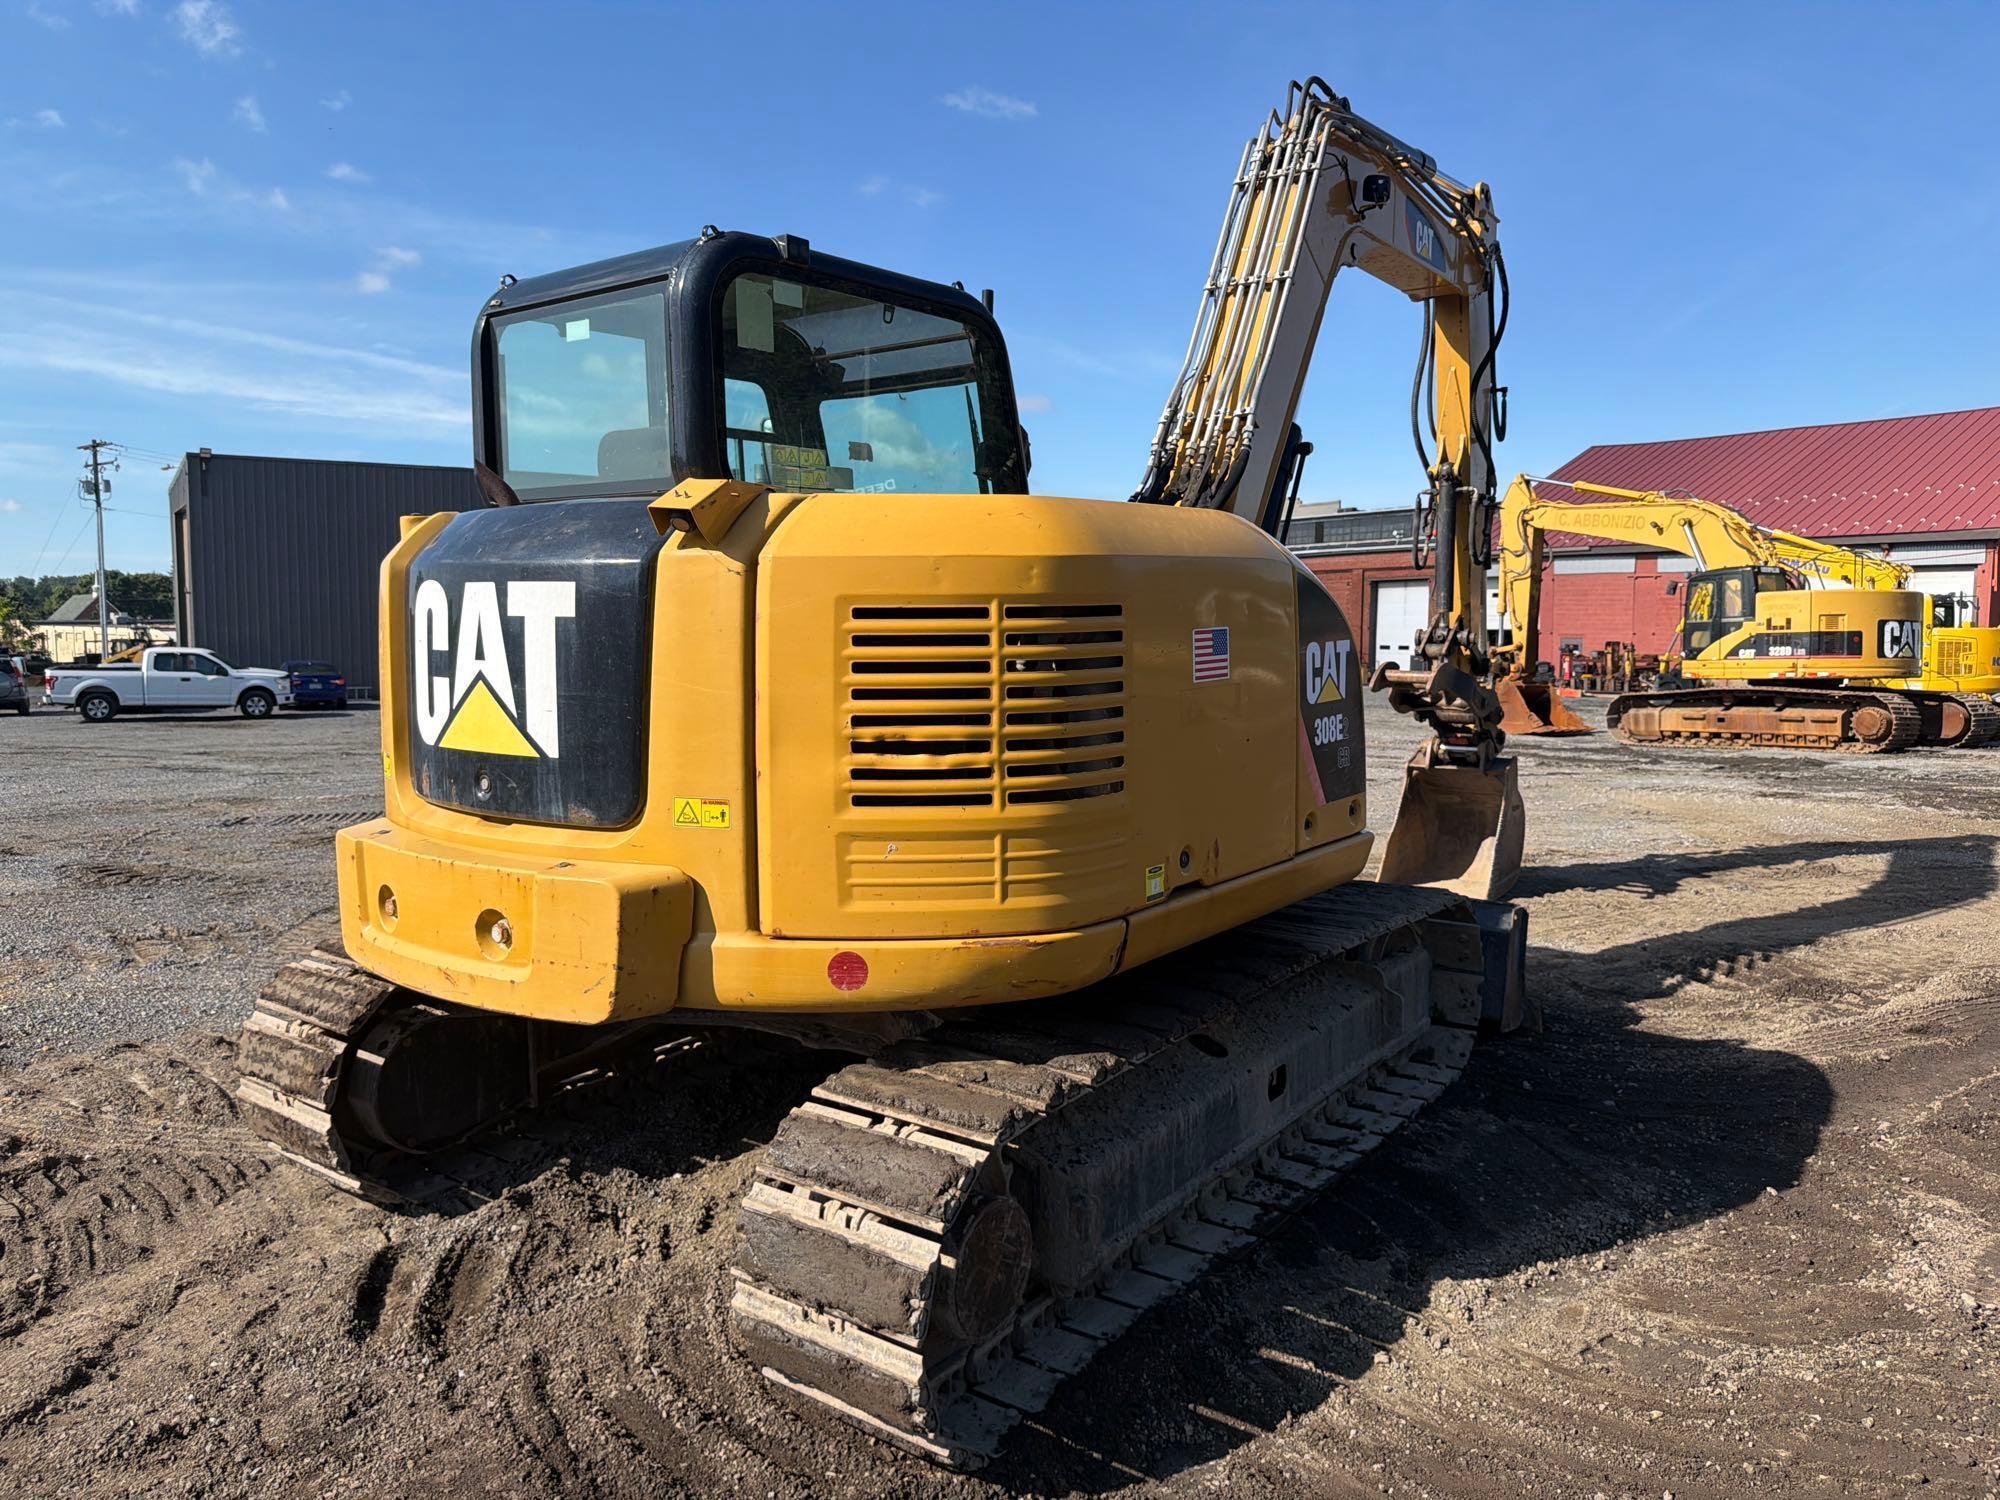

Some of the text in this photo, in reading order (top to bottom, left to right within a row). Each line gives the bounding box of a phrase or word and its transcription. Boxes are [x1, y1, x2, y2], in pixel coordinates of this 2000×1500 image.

[1416, 220, 1434, 261] CAT
[1559, 512, 1646, 530] C. ABBONIZIO
[1739, 648, 1756, 659] CAT
[1884, 621, 1921, 658] CAT
[415, 579, 576, 759] CAT
[1306, 639, 1350, 704] CAT
